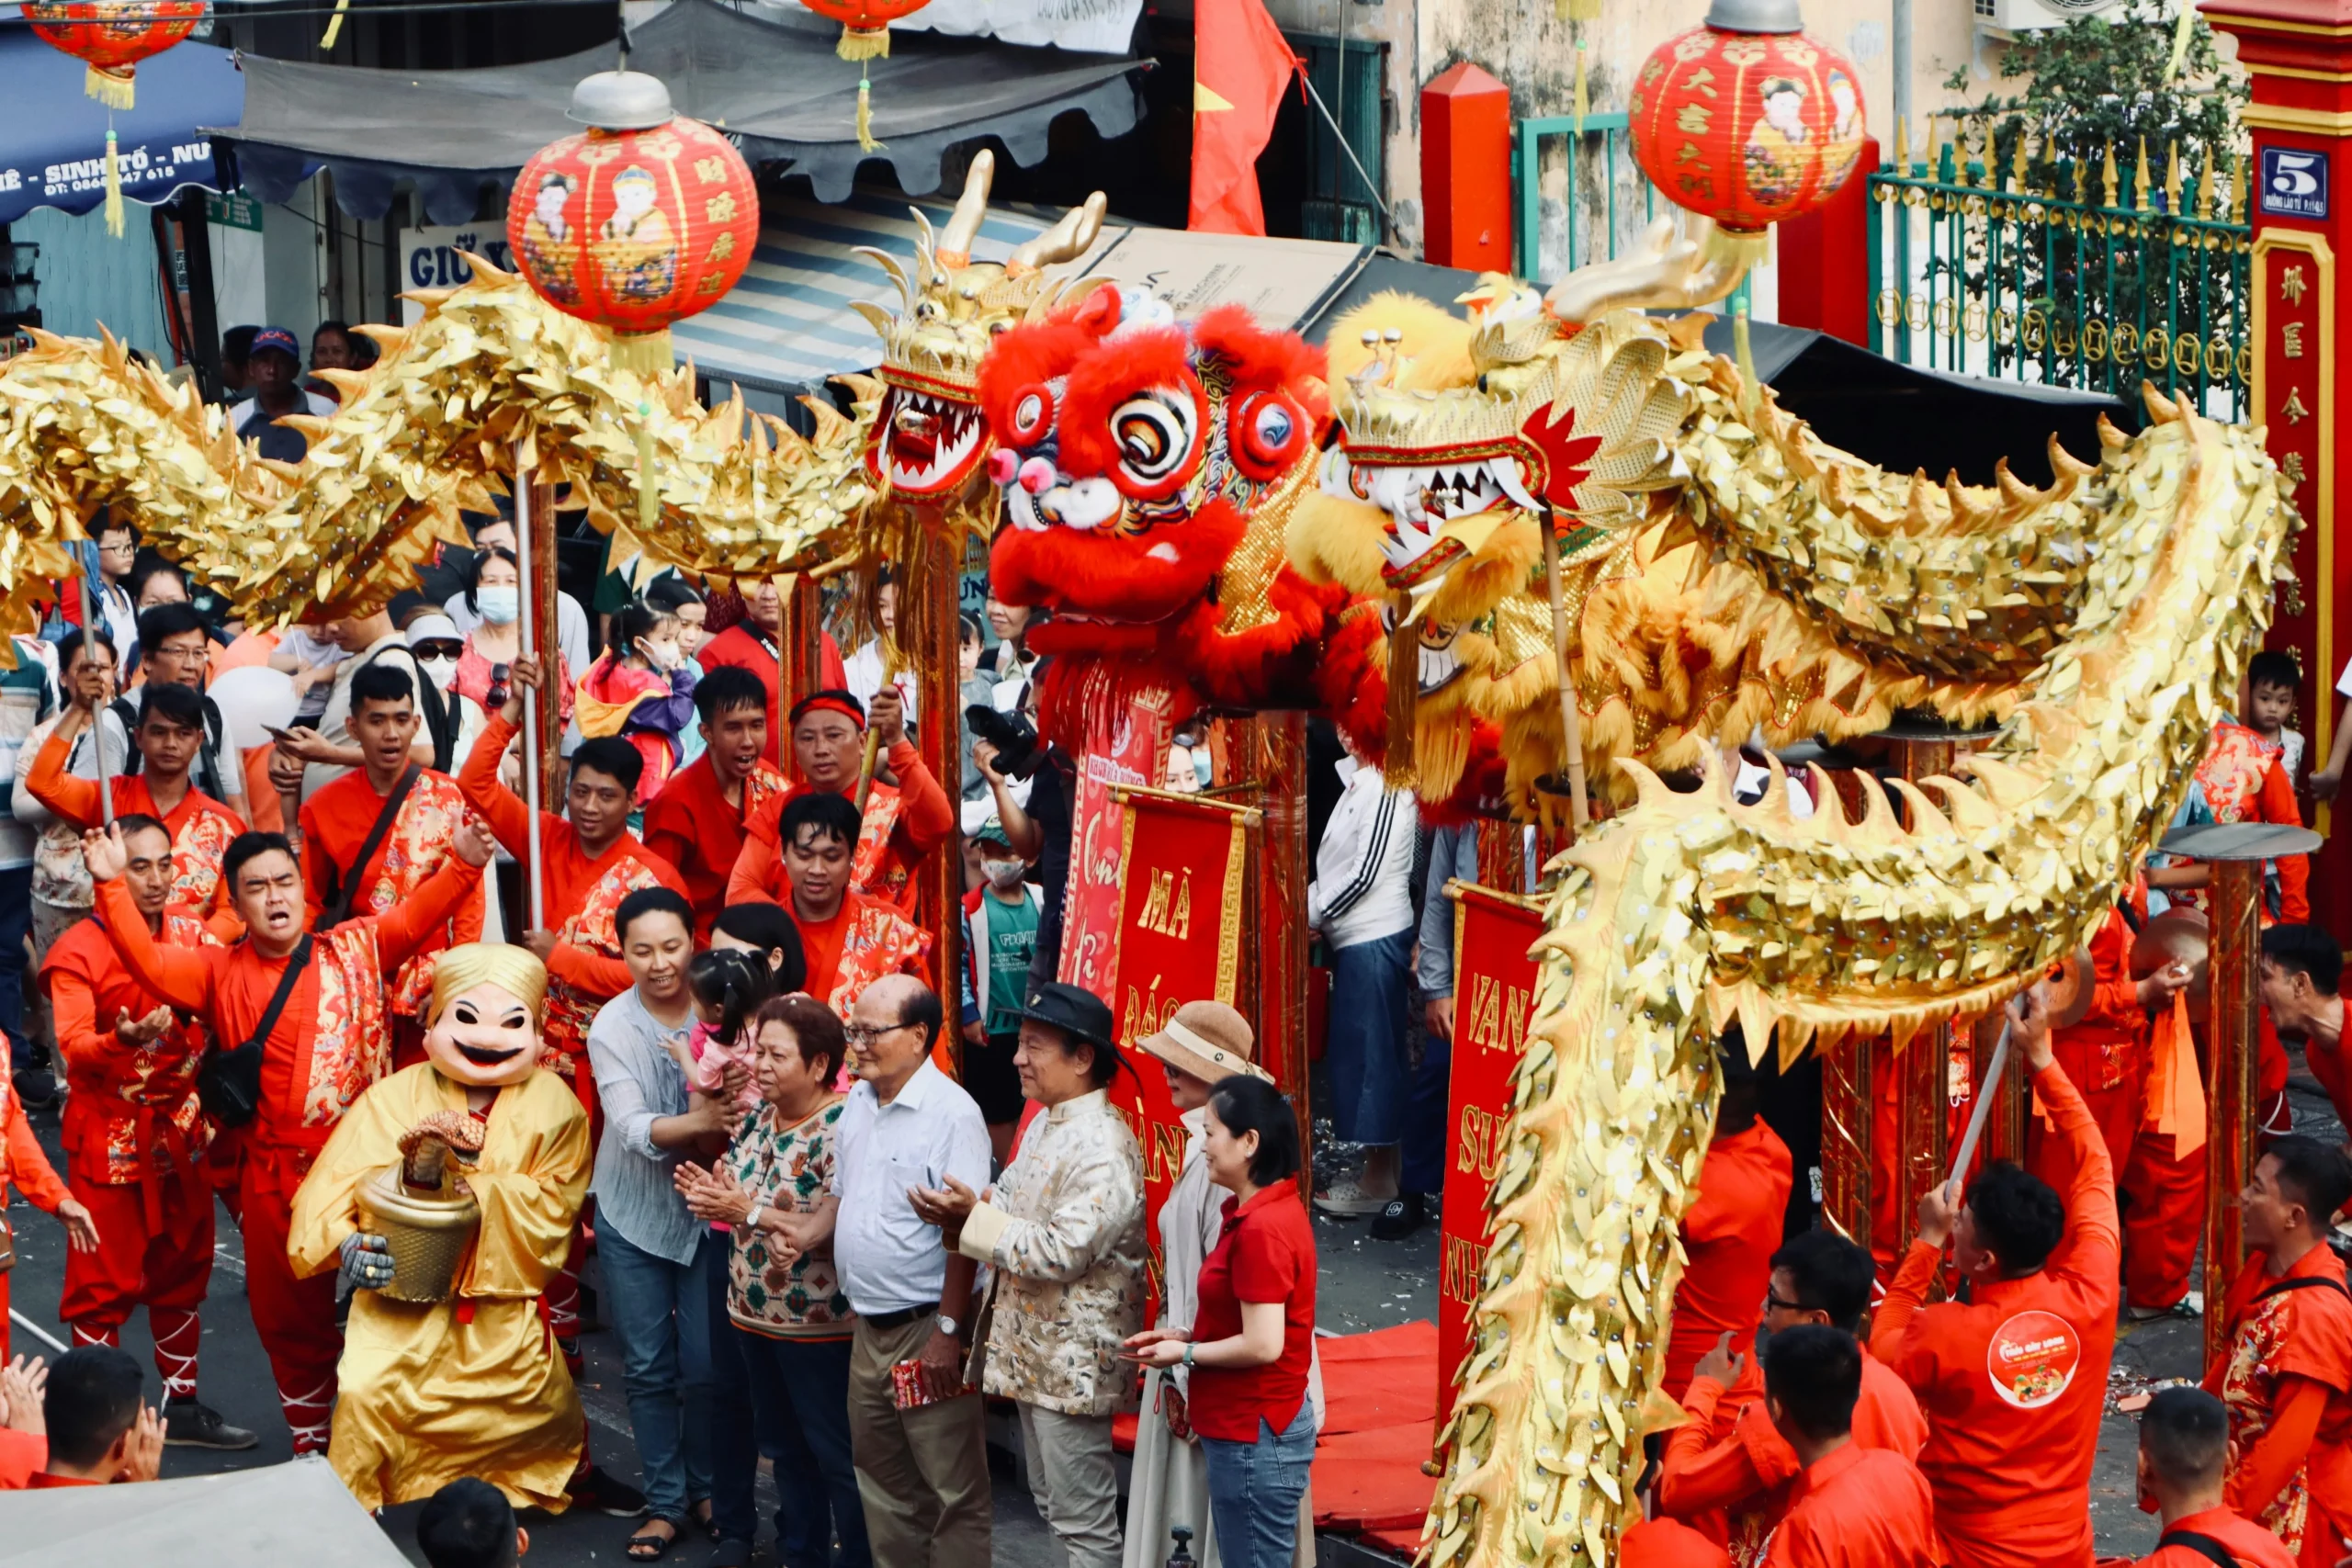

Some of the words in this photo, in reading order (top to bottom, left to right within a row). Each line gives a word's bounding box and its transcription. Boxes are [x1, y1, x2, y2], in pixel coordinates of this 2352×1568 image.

[44, 184, 69, 197] ĐT:
[146, 166, 175, 180] 615
[45, 158, 107, 184] SINH
[118, 145, 149, 173] TỐ
[2273, 153, 2317, 195] 5
[411, 232, 476, 288] GIỮ
[1137, 866, 1192, 940] MÃ
[1468, 973, 1529, 1055] VẠN
